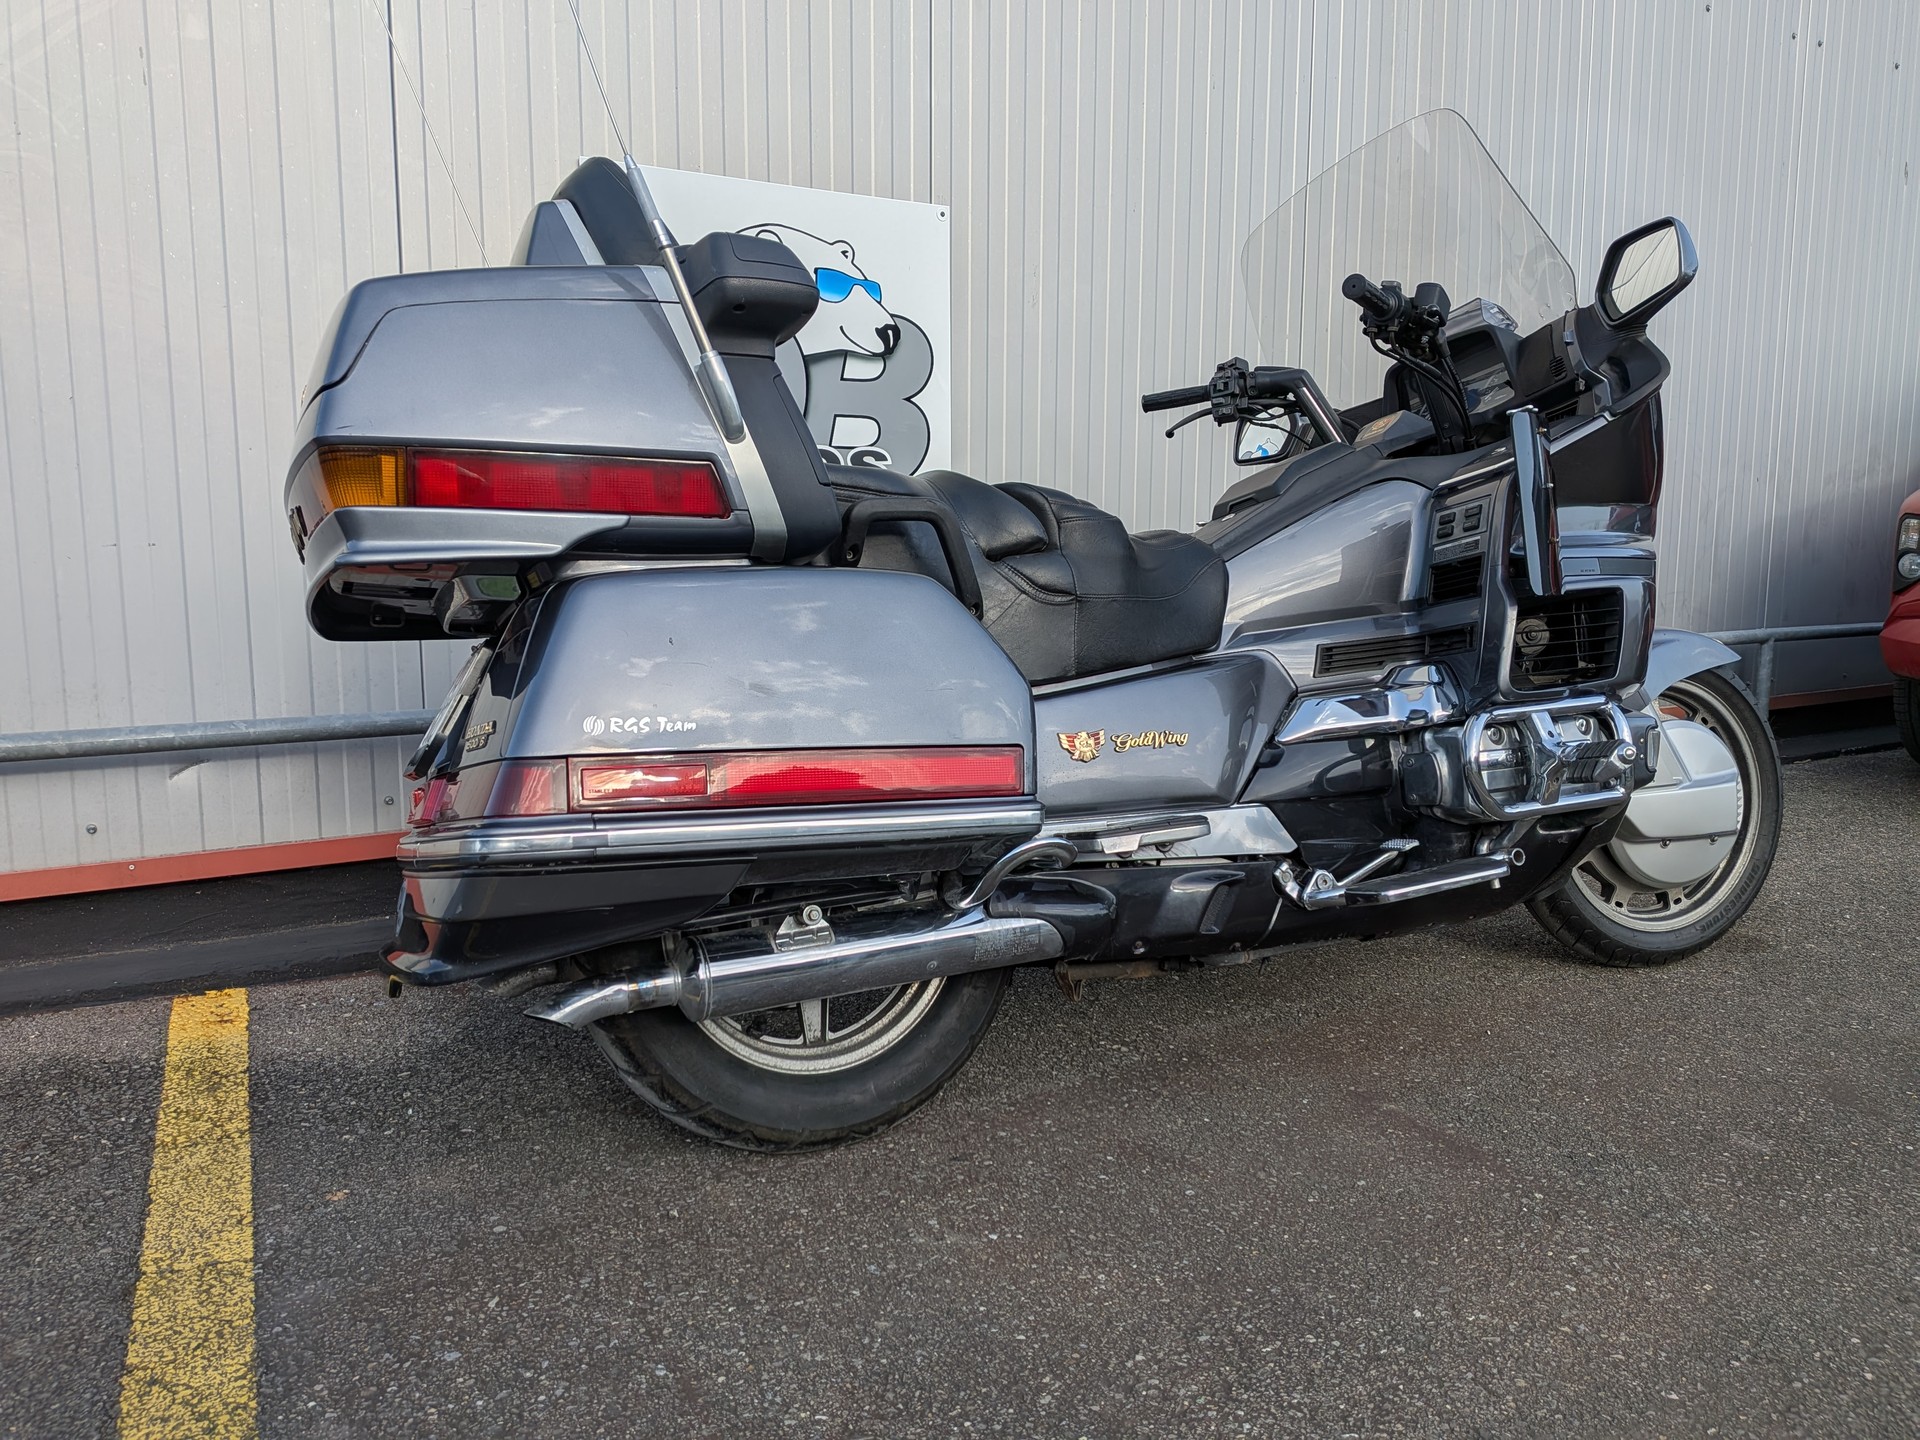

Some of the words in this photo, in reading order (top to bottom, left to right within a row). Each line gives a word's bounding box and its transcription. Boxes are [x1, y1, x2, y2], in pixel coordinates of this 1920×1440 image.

[609, 716, 650, 733] RGS
[656, 716, 697, 733] Team
[1699, 861, 1761, 933] BRIDGESTONE
